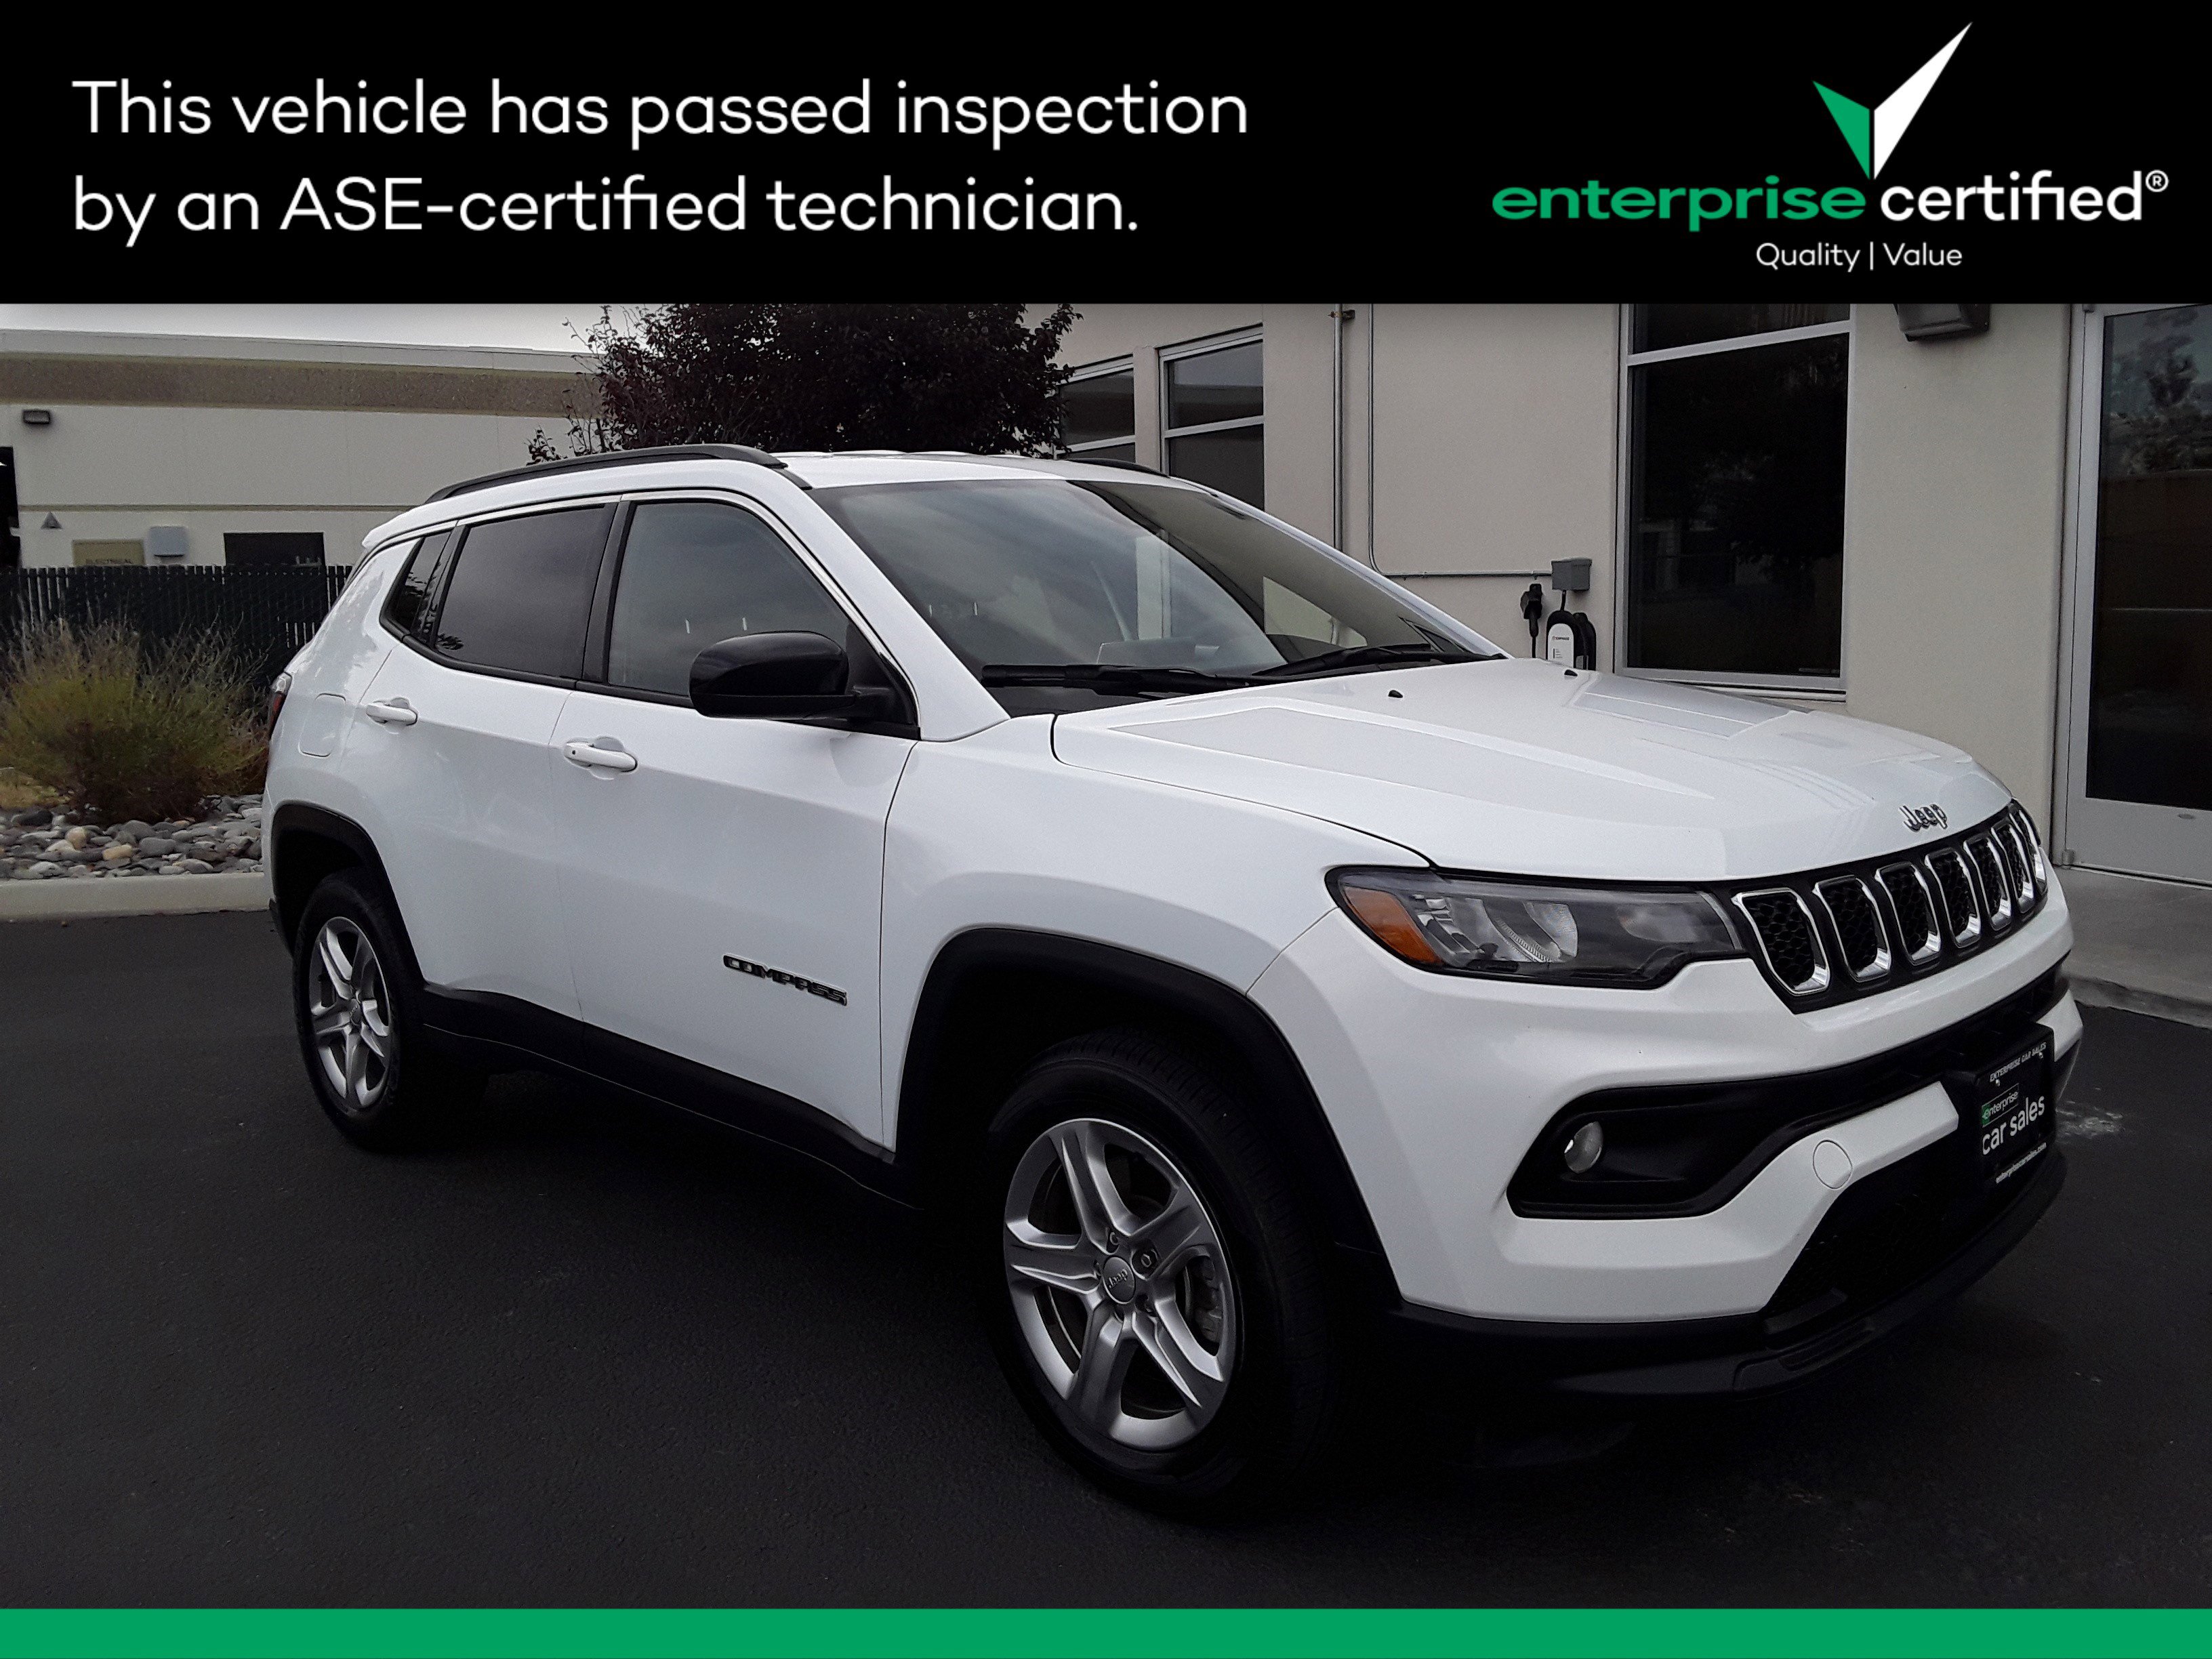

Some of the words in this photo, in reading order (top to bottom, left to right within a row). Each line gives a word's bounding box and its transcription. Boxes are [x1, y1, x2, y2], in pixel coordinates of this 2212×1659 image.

[1898, 804, 1948, 832] Jeep
[722, 954, 847, 1006] COMPASS
[1982, 1091, 2019, 1120] enterprise
[1982, 1122, 2007, 1155] car
[2010, 1096, 2045, 1136] sales
